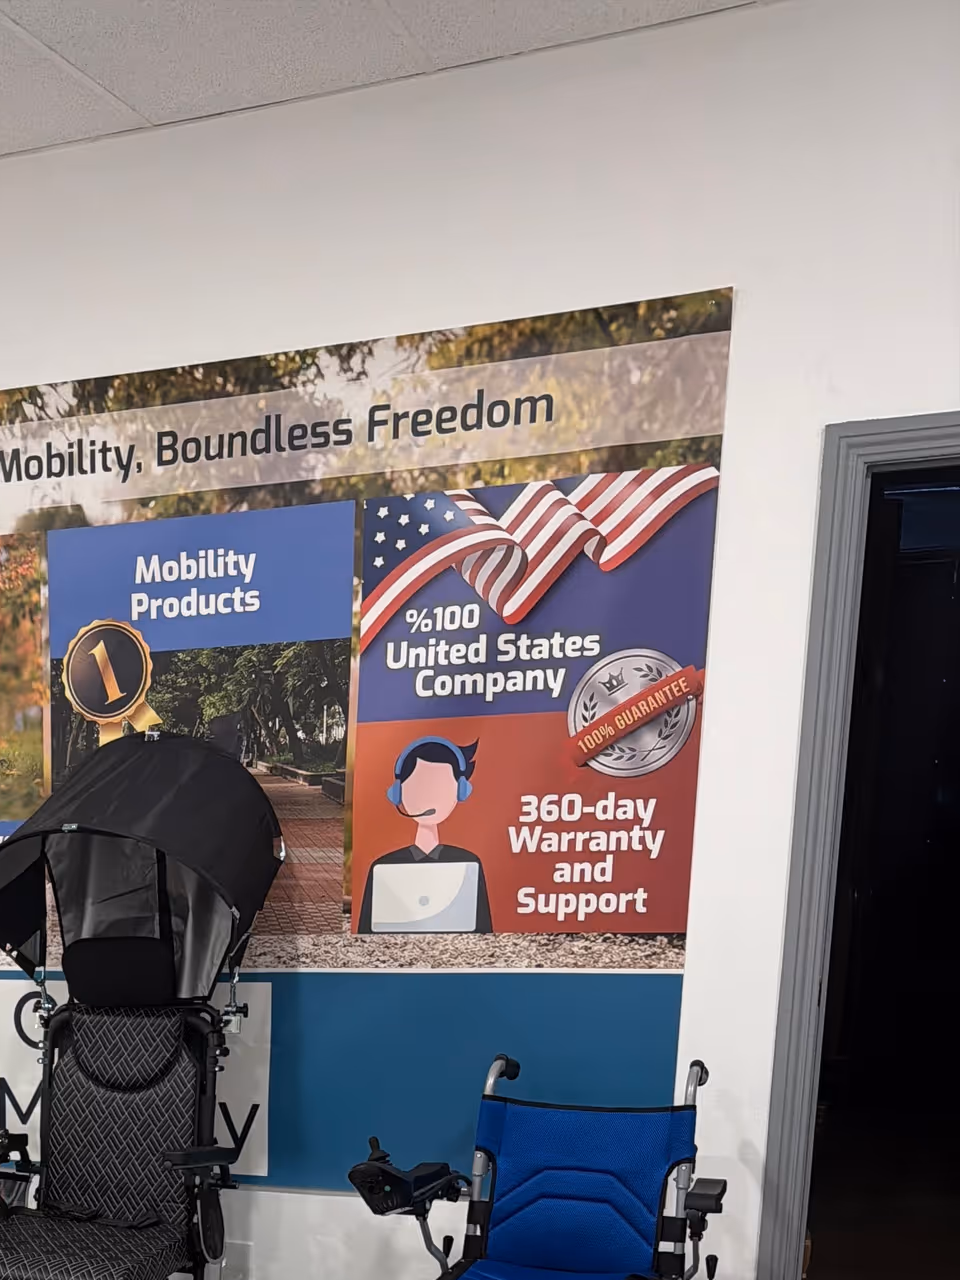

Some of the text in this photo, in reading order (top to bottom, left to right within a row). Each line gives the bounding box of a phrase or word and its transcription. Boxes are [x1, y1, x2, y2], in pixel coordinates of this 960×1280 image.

[155, 414, 353, 468] Boundless
[367, 388, 554, 443] Freedom
[134, 548, 257, 584] Mobility
[130, 586, 261, 621] Products
[405, 603, 480, 633] %100
[386, 631, 601, 669] United States
[88, 640, 127, 705] 1
[415, 666, 566, 701] Company
[577, 677, 690, 753] 100% GUARANTEE
[518, 792, 657, 827] 360-day
[508, 824, 665, 858] Warranty
[553, 855, 614, 883] and
[516, 886, 648, 921] Support
